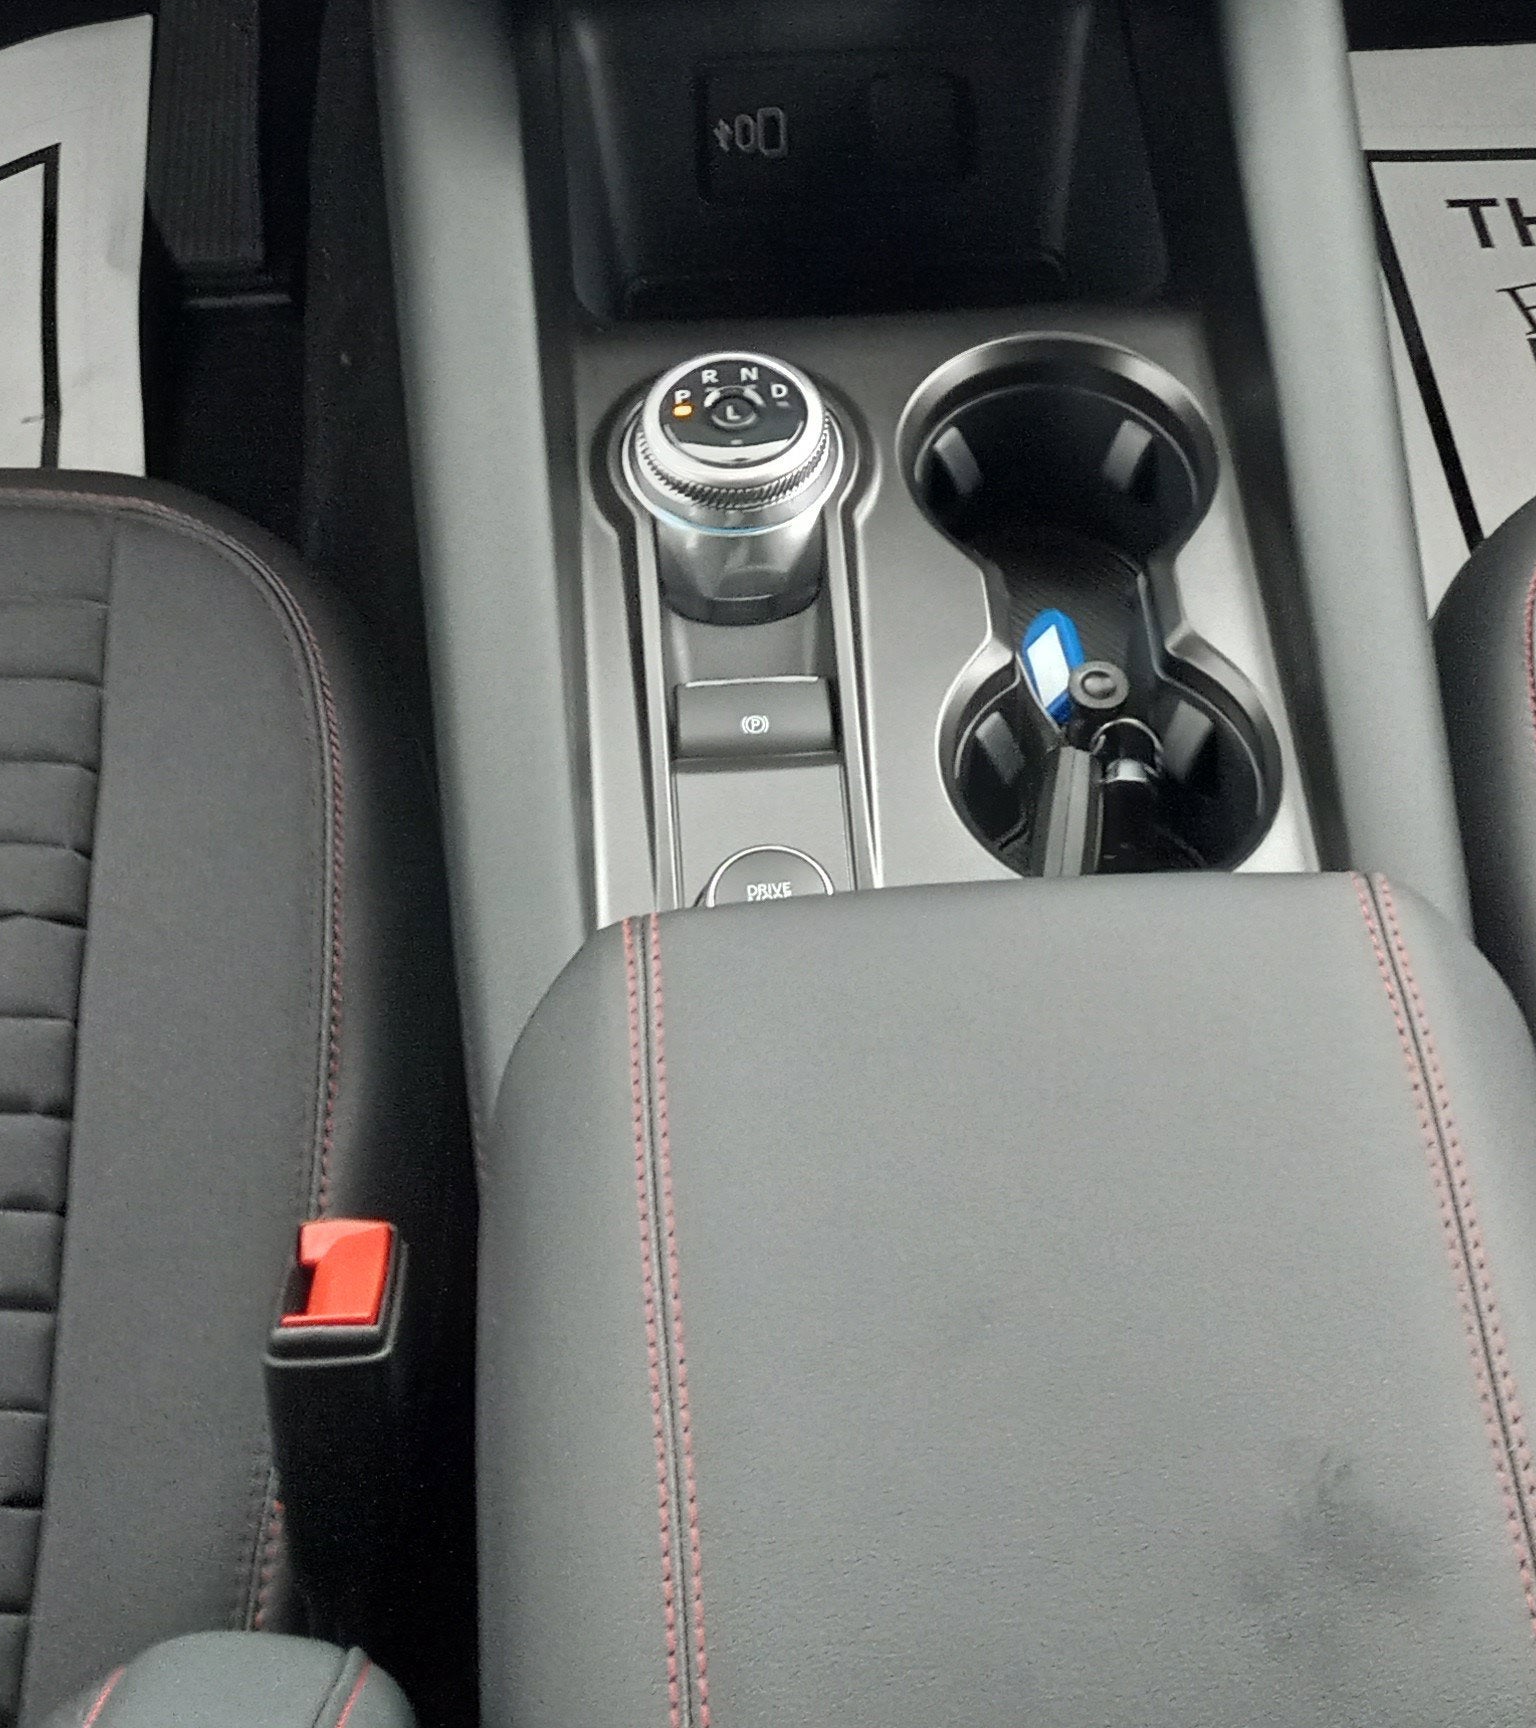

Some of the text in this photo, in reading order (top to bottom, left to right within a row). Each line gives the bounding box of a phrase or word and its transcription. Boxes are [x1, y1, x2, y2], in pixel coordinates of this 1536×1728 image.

[701, 369, 719, 384] R
[740, 367, 759, 382] N
[674, 389, 691, 404] P
[771, 383, 789, 399] D
[726, 405, 741, 421] L
[746, 881, 792, 896] DRIVE
